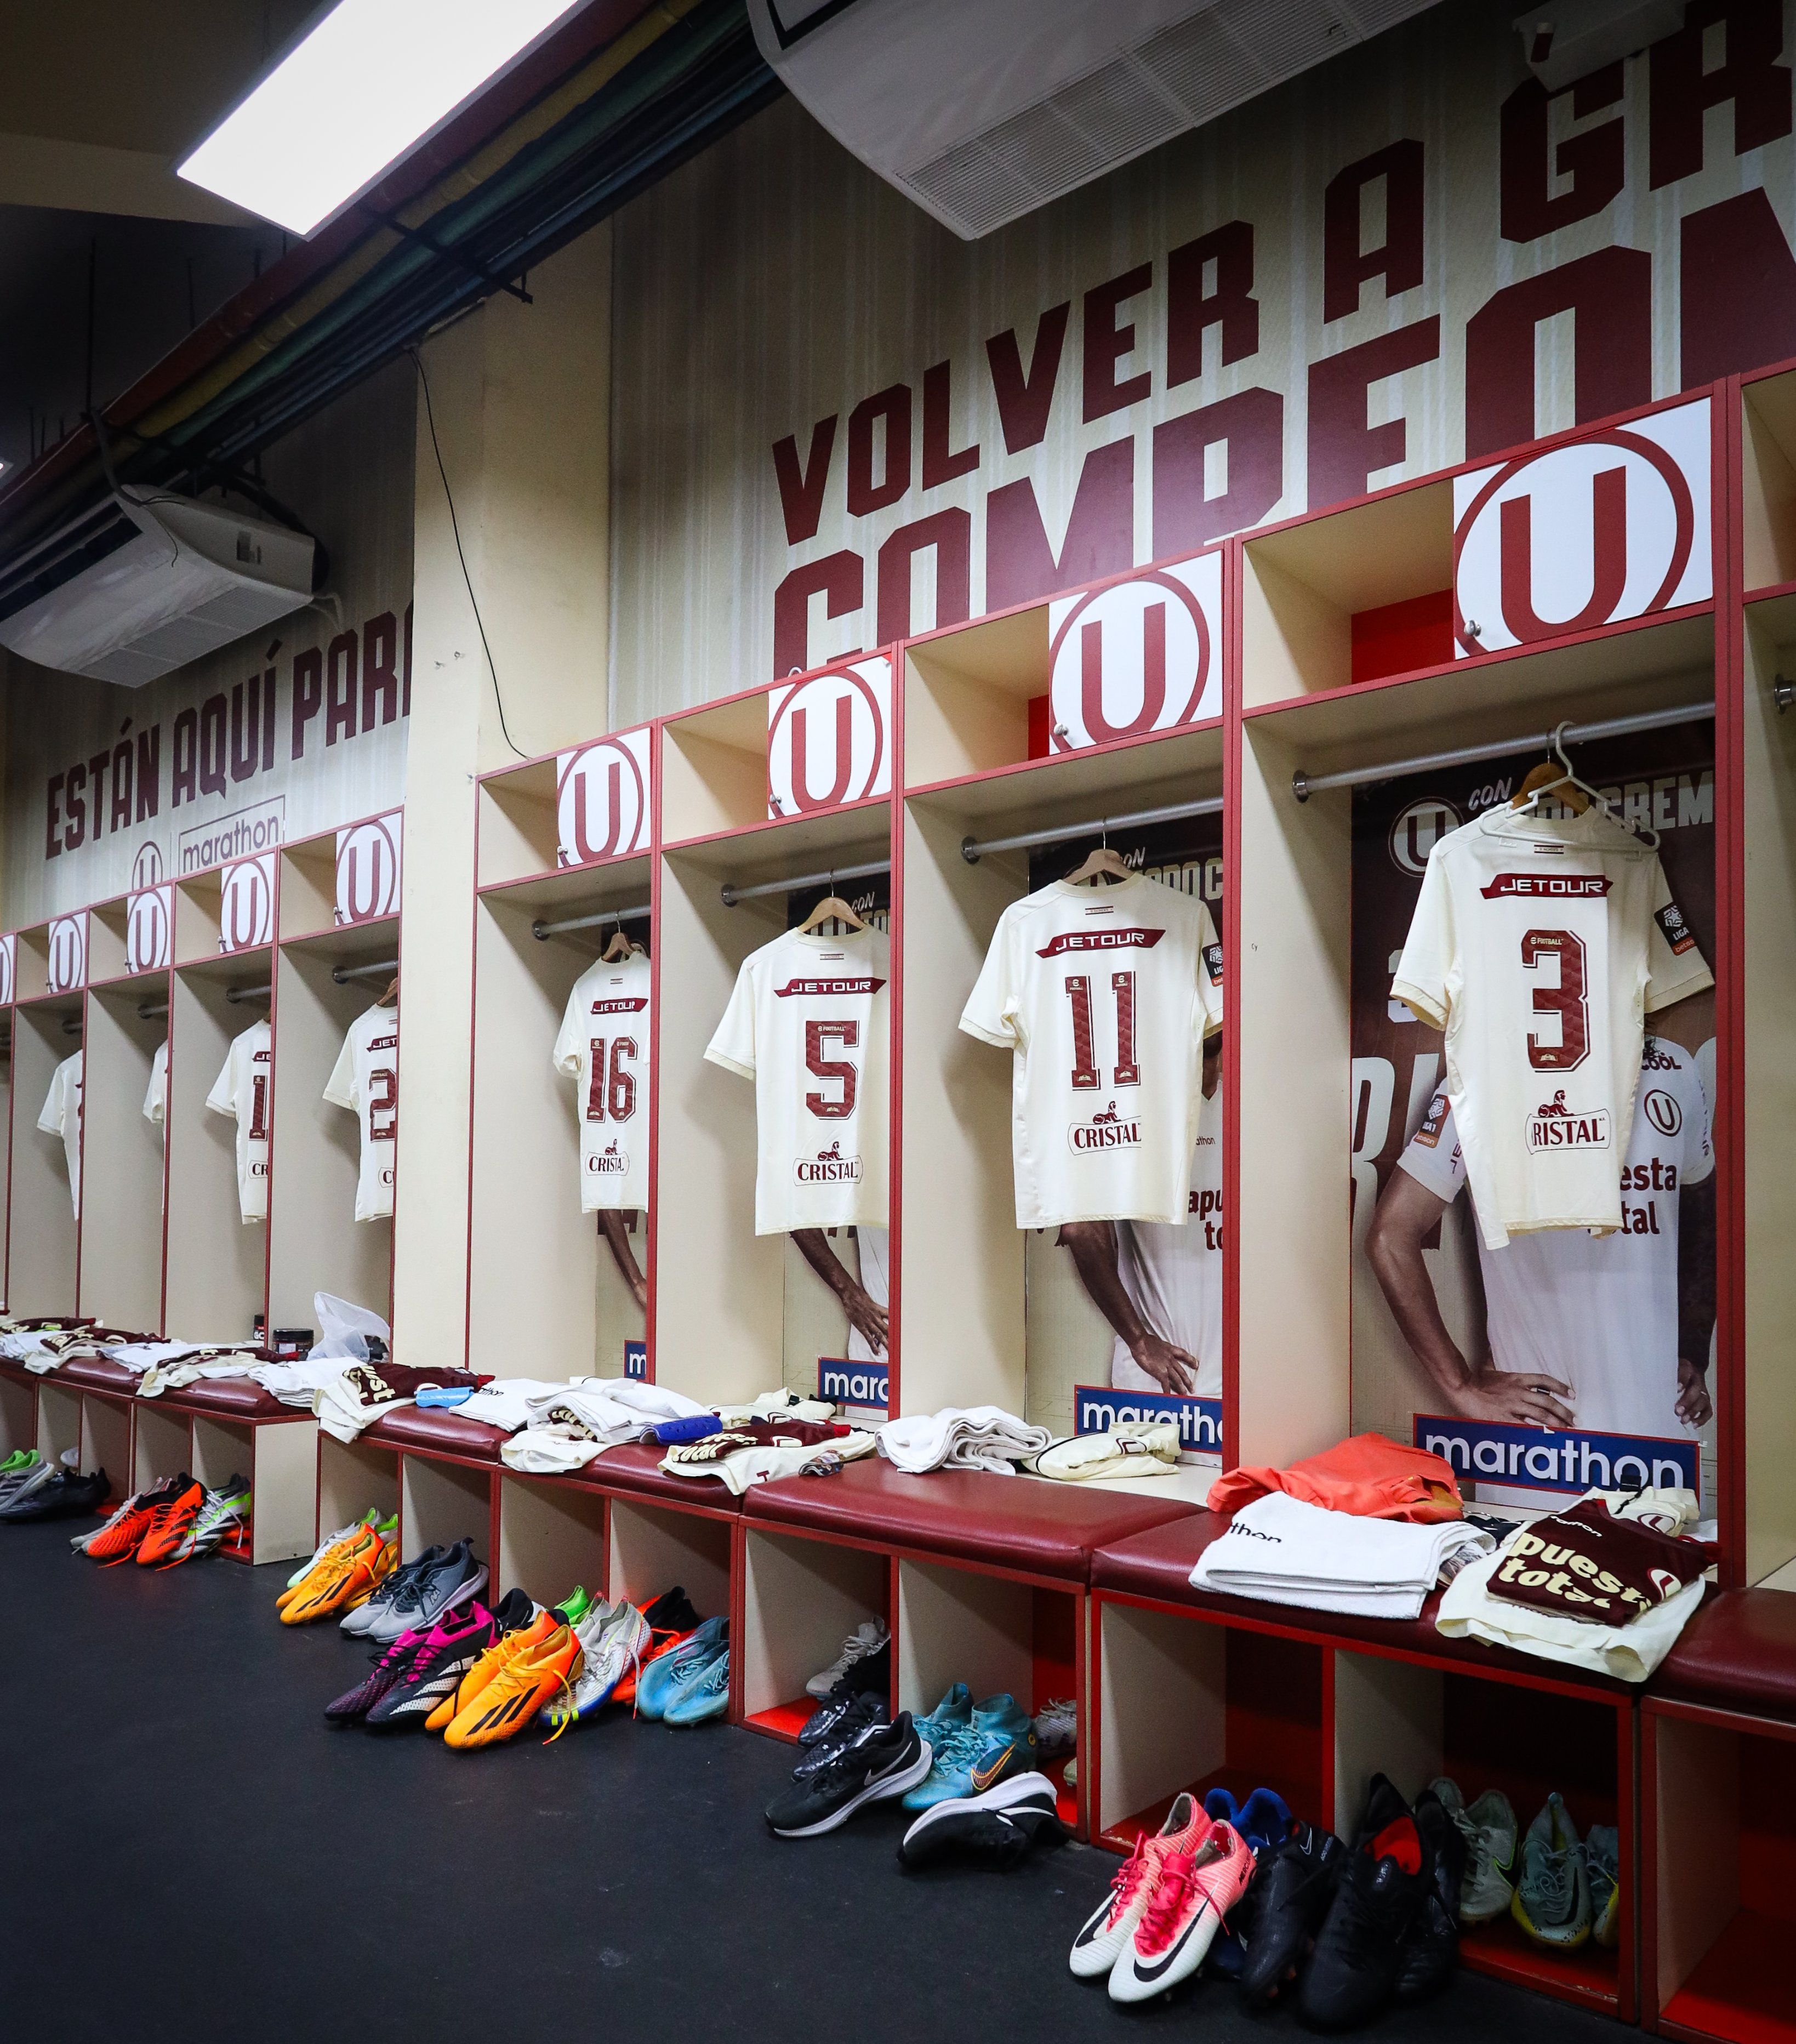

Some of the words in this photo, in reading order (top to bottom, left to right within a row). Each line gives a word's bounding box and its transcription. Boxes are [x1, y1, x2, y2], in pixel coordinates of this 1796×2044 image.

[773, 219, 1259, 547] VOLVER
[1323, 138, 1424, 324] A
[1500, 465, 1627, 645] U
[1081, 601, 1166, 744] U
[46, 716, 161, 859] ESTÁN
[172, 638, 282, 809] AQUÍ
[791, 694, 852, 813] U
[574, 761, 620, 863] U
[1468, 777, 1513, 811] CON
[183, 816, 279, 874] marathon
[348, 839, 380, 922] U
[231, 876, 258, 950] U
[1500, 878, 1604, 893] JETOUR
[135, 905, 157, 972] U
[1055, 932, 1145, 952] JETOUR
[593, 1000, 636, 1012] JETOUR
[791, 981, 871, 993] JETOUR
[1521, 929, 1591, 1073] 3
[1064, 970, 1141, 1091] 11
[586, 1035, 638, 1124] 16
[805, 1020, 859, 1120] 5
[1074, 1123, 1142, 1149] CRISTAL
[1651, 1098, 1675, 1131] U
[797, 1162, 859, 1181] CRISTAL
[1426, 1433, 1684, 1491] marathon
